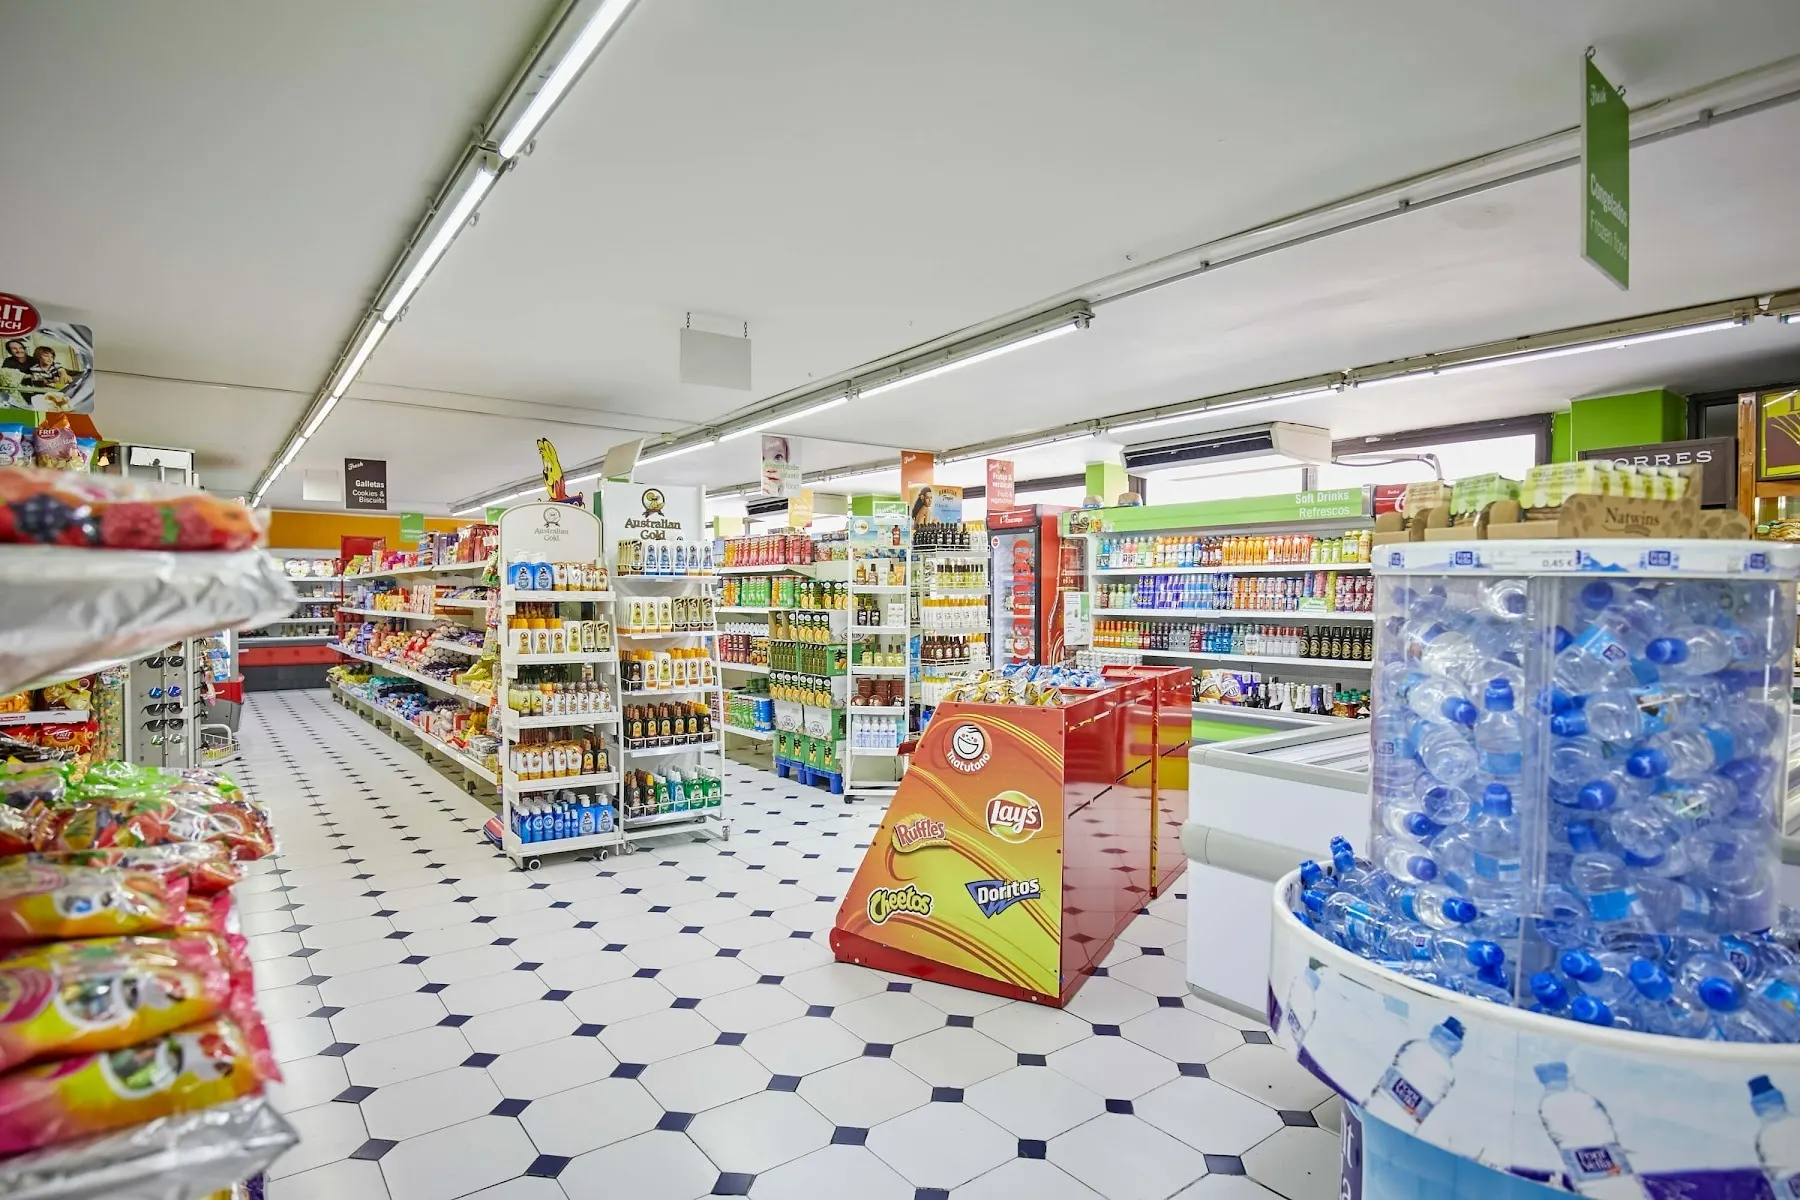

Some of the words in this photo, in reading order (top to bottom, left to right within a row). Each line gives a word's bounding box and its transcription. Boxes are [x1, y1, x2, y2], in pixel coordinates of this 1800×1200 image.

[1590, 173, 1628, 228] Congelados
[1590, 210, 1613, 247] Frozen
[1613, 232, 1628, 261] food
[0, 304, 29, 322] IT
[0, 321, 21, 330] ICH
[352, 489, 378, 497] Cookies
[355, 480, 385, 488] Galletas
[358, 496, 385, 504] Biscuits
[1295, 493, 1314, 504] Soft
[1317, 491, 1349, 502] Drinks
[1299, 506, 1350, 518] Refrescos
[1605, 507, 1660, 526] Natwins
[625, 518, 681, 530] Australian
[640, 530, 666, 541] Gold
[947, 749, 990, 772] matutano
[990, 800, 1038, 833] Lay's
[895, 818, 946, 847] Ruffles
[977, 878, 1040, 905] Doritos
[869, 885, 931, 923] Cheetos
